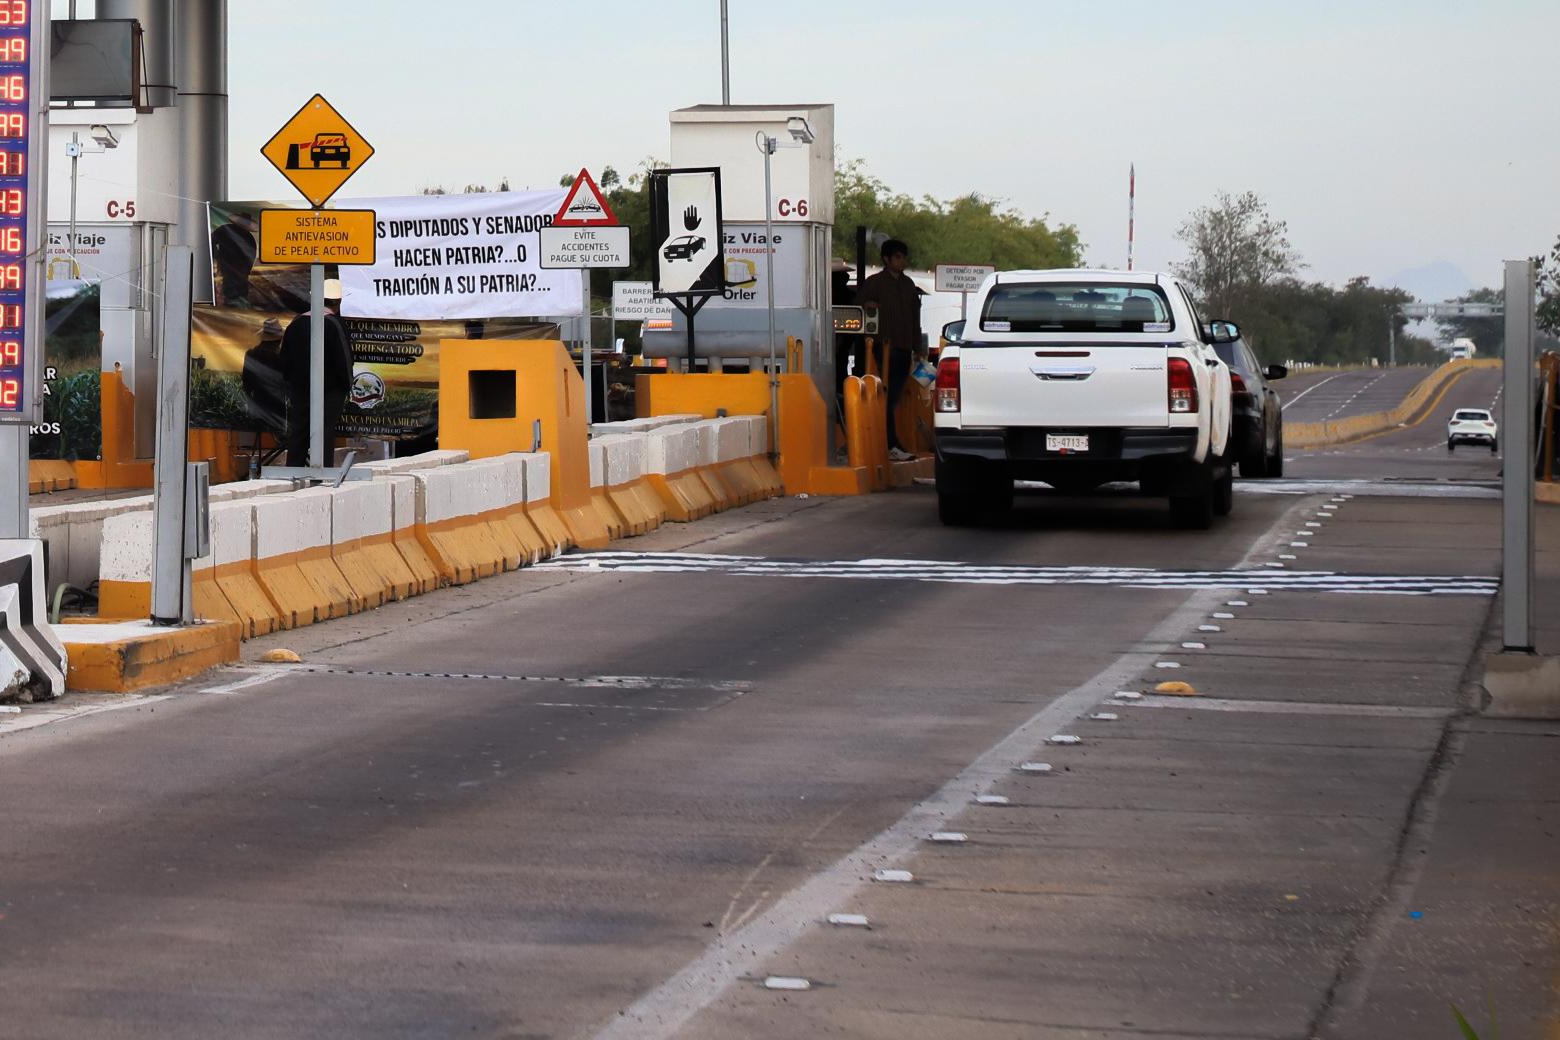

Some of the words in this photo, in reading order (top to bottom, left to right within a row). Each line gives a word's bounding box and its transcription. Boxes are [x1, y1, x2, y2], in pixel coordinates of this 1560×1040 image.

[107, 200, 136, 218] C-5
[778, 198, 808, 217] C-6
[296, 217, 338, 227] SISTEMA
[390, 218, 469, 239] DIPUTADOS
[469, 217, 482, 235] Y
[285, 232, 349, 241] ANTIEVASION
[574, 231, 596, 240] EVITE
[274, 246, 287, 256] DE
[291, 246, 319, 256] PEAJE
[323, 246, 359, 256] ACTIVO
[561, 243, 610, 251] ACCIDENTES
[394, 247, 442, 267] HACEN
[550, 254, 577, 263] PAGUE
[580, 254, 590, 262] SU
[592, 254, 620, 262] CUOTA
[373, 274, 440, 297] TRAICIÓN
[444, 277, 454, 294] A
[458, 276, 476, 294] SU
[480, 273, 552, 293] PATRIA?...
[722, 288, 757, 300] Orler
